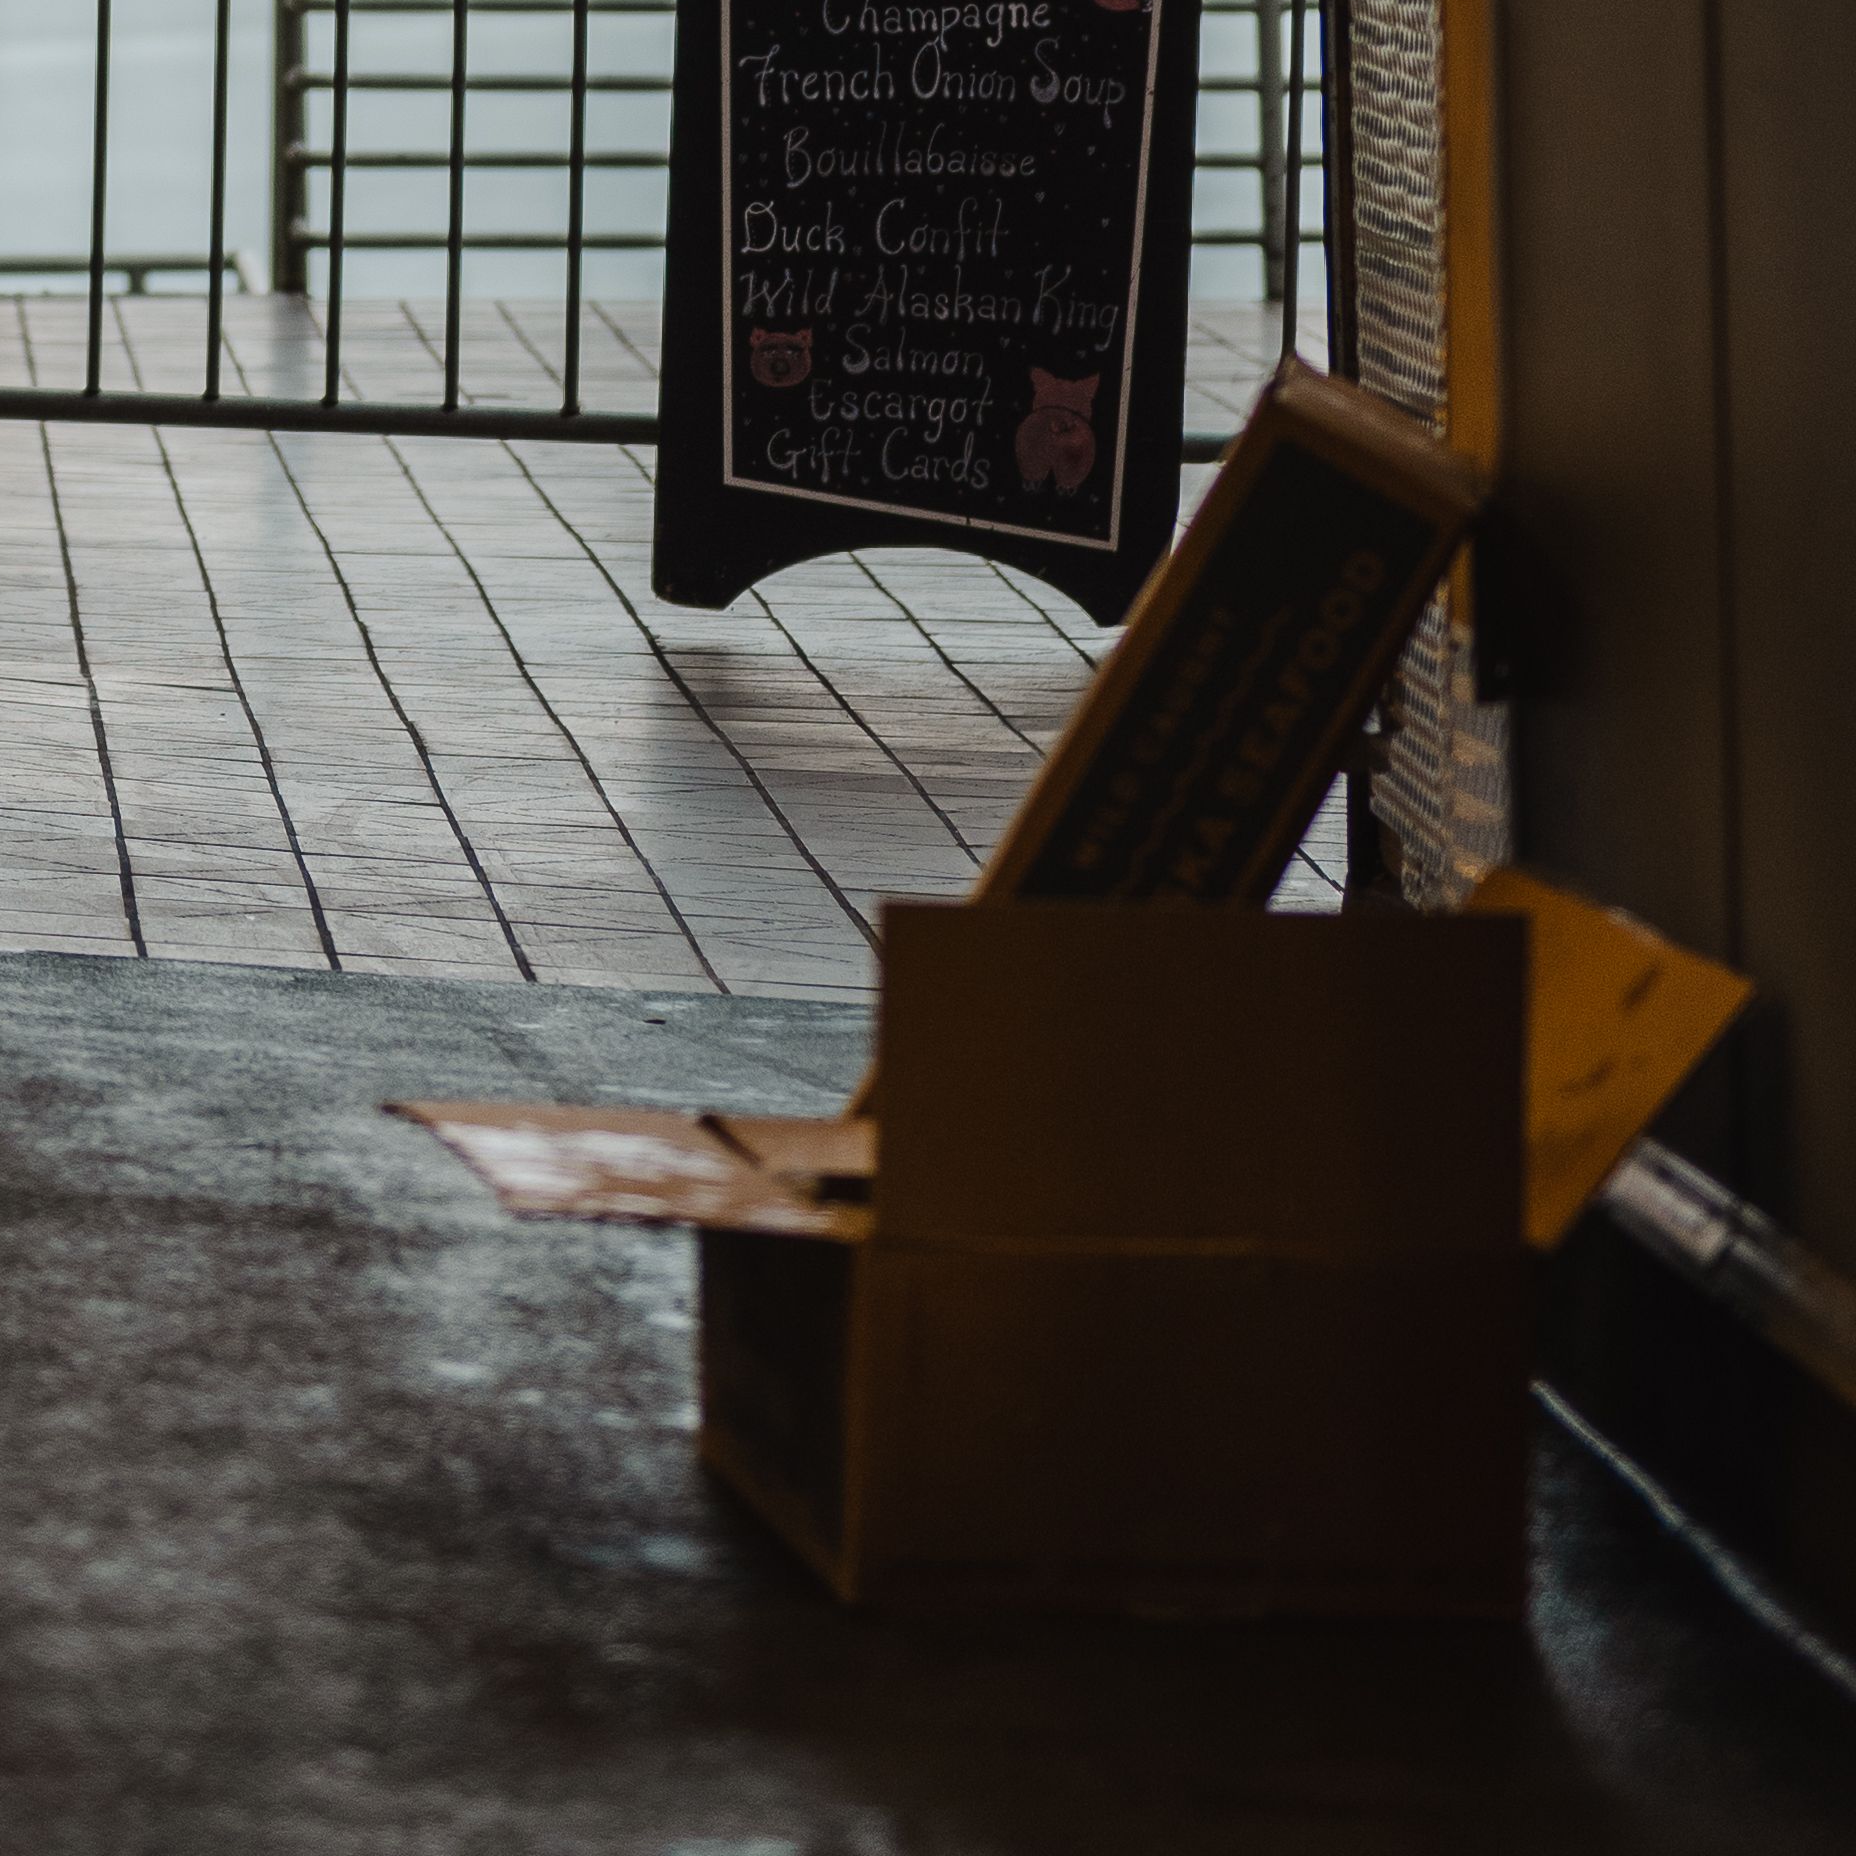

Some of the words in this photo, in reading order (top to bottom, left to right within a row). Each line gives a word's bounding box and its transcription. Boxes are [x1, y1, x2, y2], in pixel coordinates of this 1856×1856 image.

[738, 43, 895, 107] French
[912, 36, 1016, 102] Onion
[1030, 37, 1126, 129] Soup
[784, 120, 1036, 188] Bouillabaisse
[740, 201, 845, 255] Duck
[875, 196, 1008, 262] Confit
[740, 266, 839, 319] Wild
[854, 263, 1021, 325] Alaskan
[1032, 264, 1120, 351] King
[843, 323, 984, 377] Salmon
[809, 376, 994, 444] Escargot
[766, 428, 861, 484] Gift
[881, 425, 990, 488] Cards
